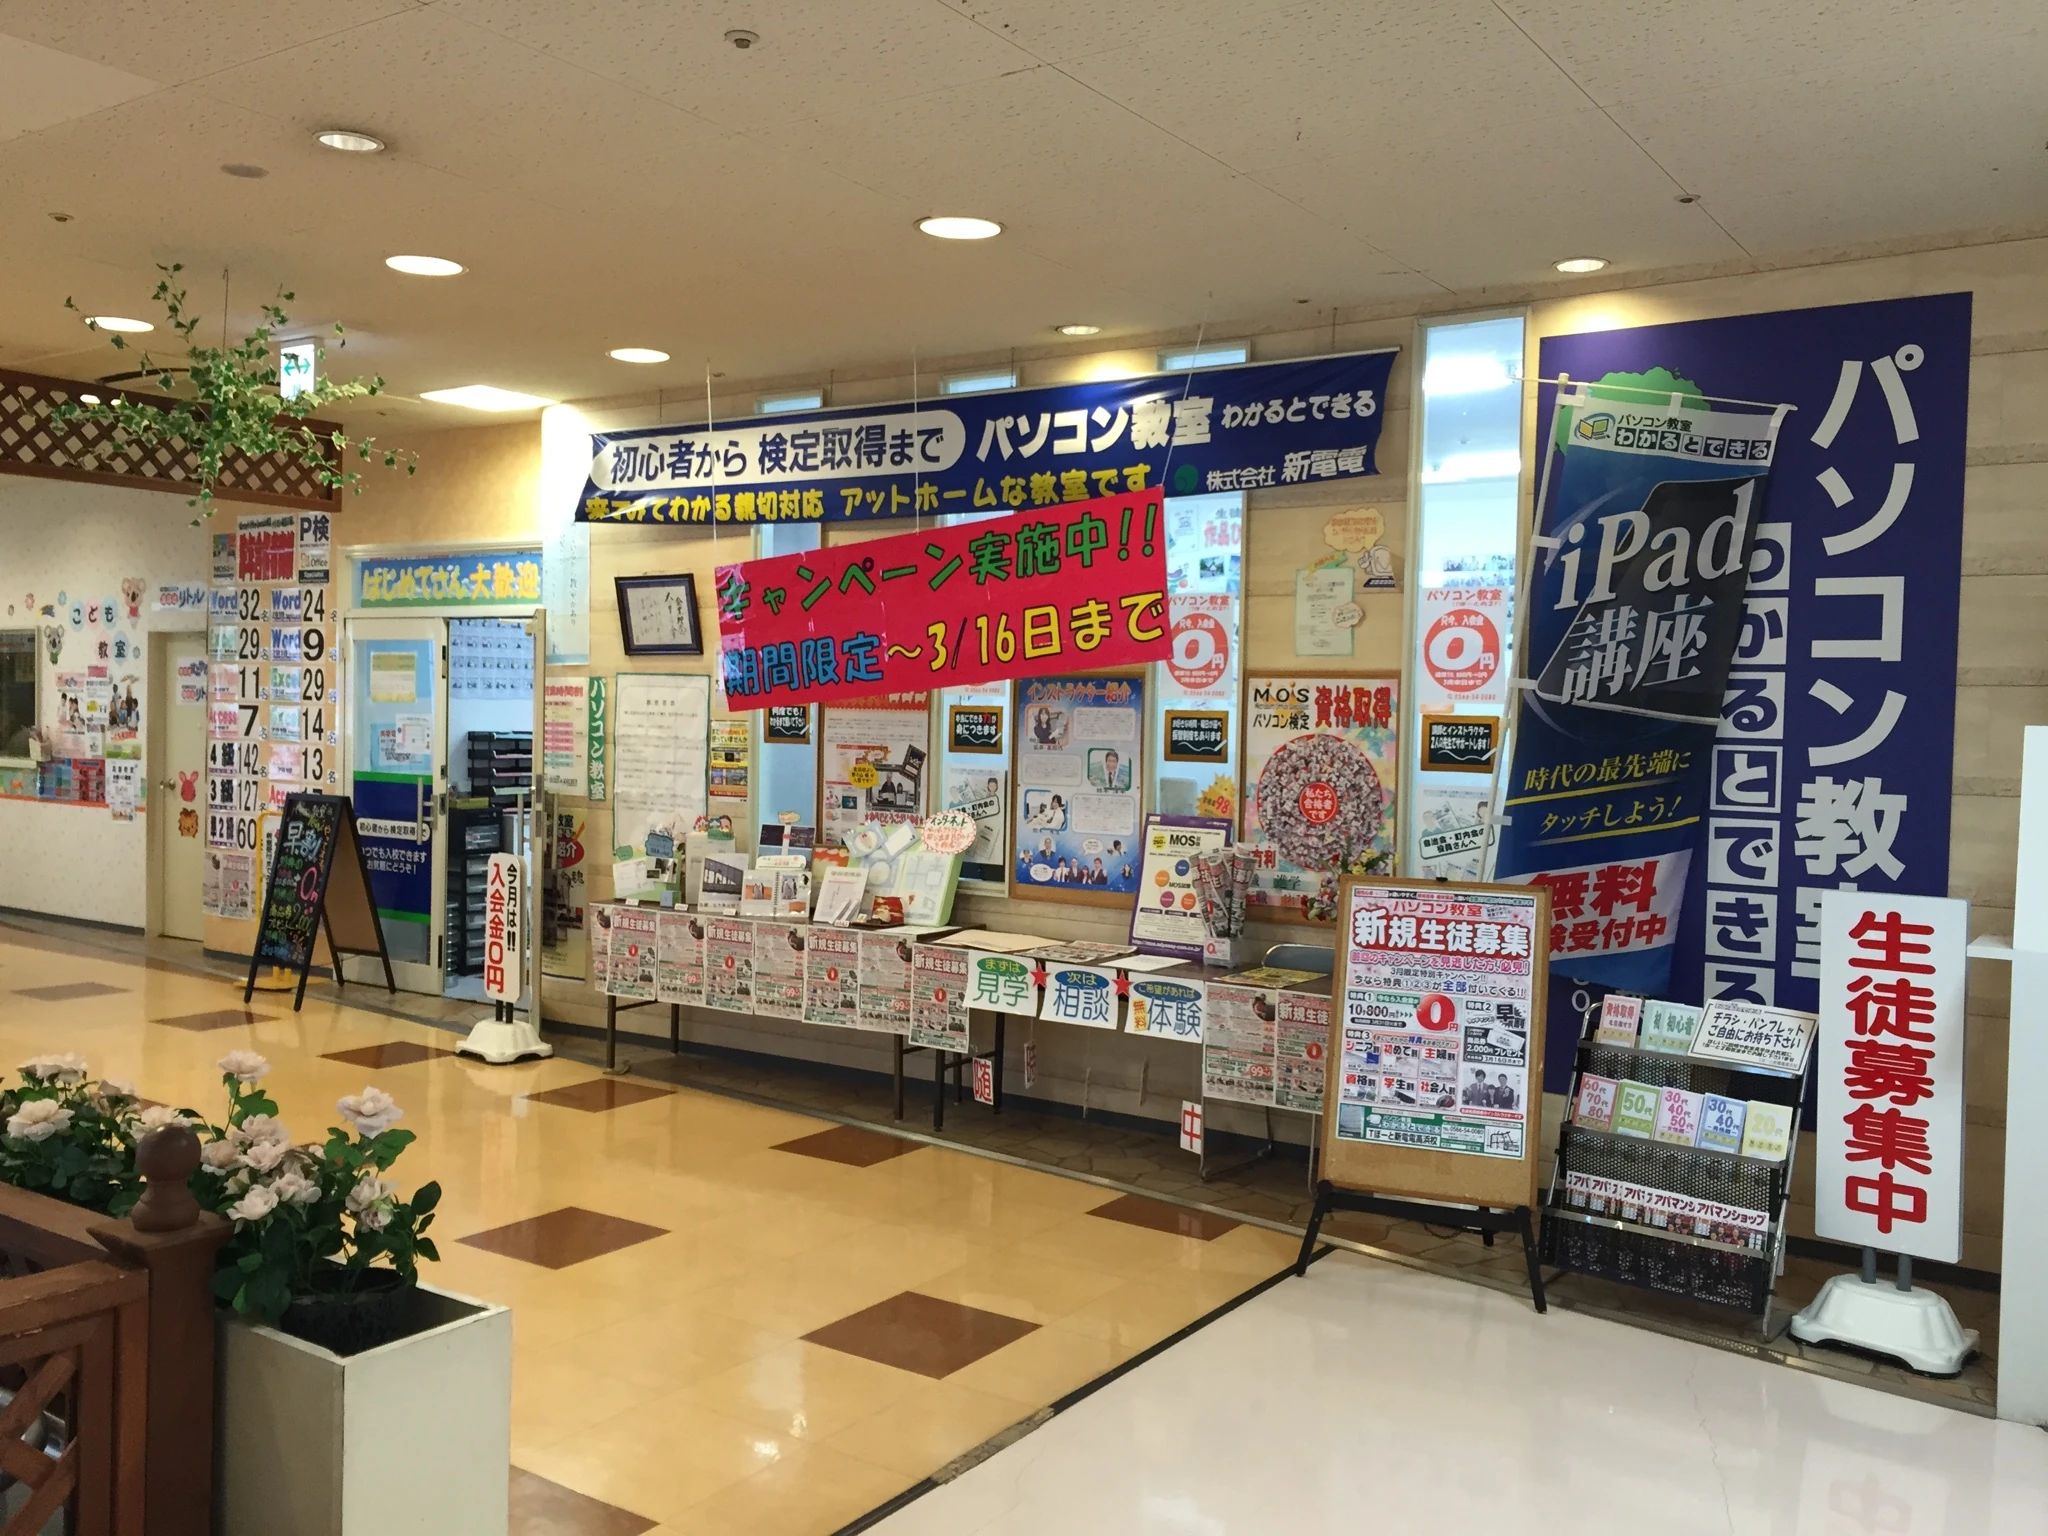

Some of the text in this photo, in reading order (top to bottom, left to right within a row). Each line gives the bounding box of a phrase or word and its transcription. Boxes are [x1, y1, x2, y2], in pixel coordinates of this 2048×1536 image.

[1220, 389, 1378, 429] わかるとできる
[1618, 413, 1693, 432] パソコン教室
[975, 394, 1214, 463] パソコン教室
[1615, 428, 1772, 460] わかるとできる
[611, 424, 945, 485] 初心者から 検定取得まで
[1206, 445, 1368, 492] 株式会社 新電電
[840, 463, 1151, 517] アットホームな教室です
[299, 514, 330, 543] P検
[1553, 478, 1756, 611] iPad
[239, 588, 260, 621] 32
[271, 590, 301, 610] Word
[303, 588, 325, 622] 24
[1169, 595, 1230, 607] パソコン教室
[1427, 588, 1502, 602] パソコン教室
[72, 605, 115, 626] こども
[98, 640, 126, 660] 教室
[239, 627, 260, 660] 29
[303, 628, 324, 661] 9
[1561, 593, 1715, 705] 講座
[239, 666, 260, 699] 11
[303, 667, 324, 702] 29
[1027, 681, 1133, 705] インストラクター紹介
[1253, 687, 1310, 704] MOS
[238, 704, 260, 737] 7
[1252, 712, 1311, 731] パソコン検定
[1314, 685, 1393, 730] 資格取得
[302, 707, 324, 741] 14
[589, 677, 607, 800] パソコン教室
[956, 724, 997, 736] 身につきます
[238, 743, 259, 775] 142
[302, 746, 323, 780] 13
[1524, 750, 1693, 792] 時代の最先端に
[238, 780, 259, 812] 127
[1303, 798, 1333, 811] 合格者
[1305, 788, 1333, 800] 私たち
[359, 821, 429, 840] 初心者から 検定取得で
[1309, 809, 1328, 821] です
[237, 818, 258, 850] 60
[1169, 834, 1196, 847] MOS
[1527, 860, 1661, 922] 無料
[1393, 901, 1483, 918] パソコン教室
[486, 862, 506, 994] 入会金0円
[1353, 907, 1531, 958] 新規生徒募集
[984, 958, 1021, 972] まずは
[1066, 971, 1098, 985] 次は
[973, 971, 1030, 1008] 見学
[1053, 985, 1110, 1023] 相談
[1136, 982, 1196, 1000] ご希望があれば
[1133, 1000, 1149, 1031] 無料
[1147, 997, 1204, 1038] 体験
[1707, 1024, 1801, 1049] ご自由にお持ち下さい
[974, 1060, 993, 1102] 随
[1842, 909, 1937, 1235] 生徒募集中
[1623, 1091, 1653, 1116] 50代
[1665, 1090, 1688, 1106] 30代
[1667, 1103, 1691, 1119] 40代
[1708, 1099, 1733, 1116] 30代
[1670, 1115, 1694, 1131] 50代
[1697, 1202, 1767, 1227] アパマンショップ
